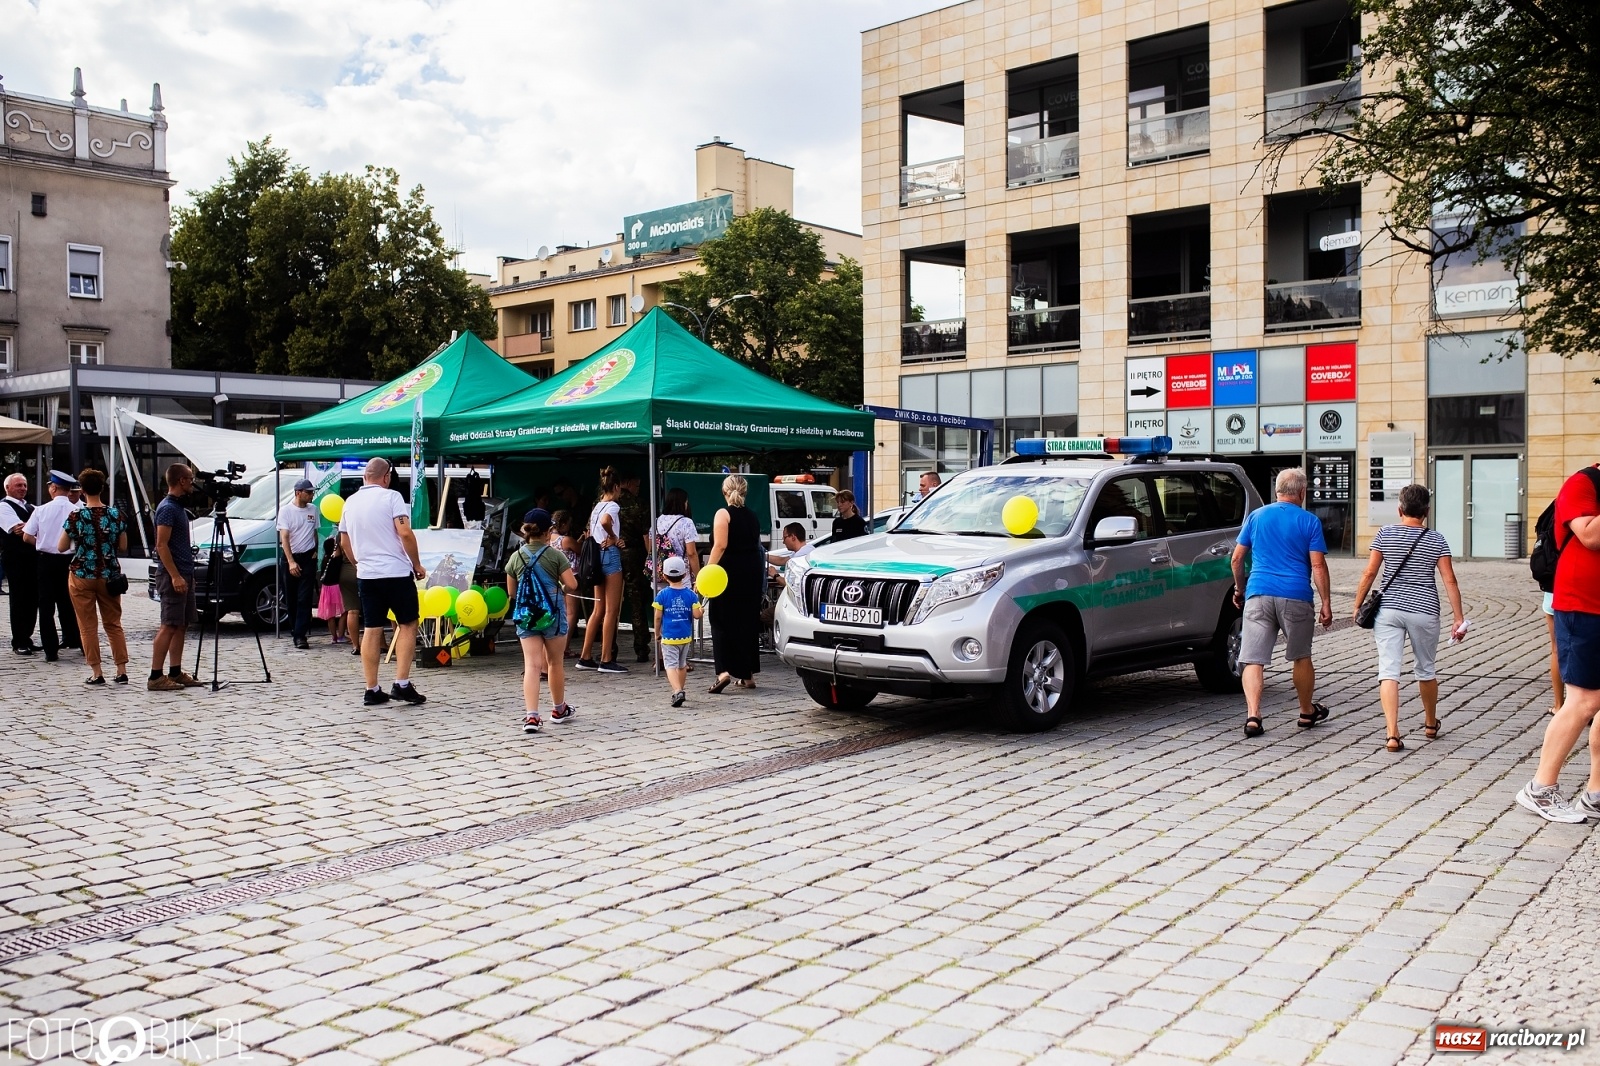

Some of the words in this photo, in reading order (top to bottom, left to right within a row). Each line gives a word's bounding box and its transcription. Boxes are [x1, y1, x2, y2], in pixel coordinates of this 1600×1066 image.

[649, 216, 705, 238] McDonald's
[627, 241, 640, 251] 300
[640, 241, 648, 249] m
[1323, 234, 1358, 249] kemøn
[1444, 284, 1513, 305] kemøn
[1136, 370, 1163, 380] PIĘTRO
[1311, 371, 1343, 380] COVEBO
[1171, 380, 1199, 389] COVEBO
[911, 411, 921, 422] Sp.
[927, 415, 939, 423] o.o.
[940, 415, 967, 426] Racibórz
[1134, 419, 1164, 430] PIĘTRO
[450, 431, 469, 442] Śląski
[470, 430, 494, 440] Oddział
[495, 428, 517, 439] Straży
[517, 425, 555, 436] Granicznej
[560, 423, 590, 433] siedzibą
[591, 423, 598, 431] w
[599, 420, 637, 430] Raciborzu
[666, 416, 692, 431] Śląski
[693, 420, 723, 431] Oddział
[724, 422, 749, 434] Straży
[750, 423, 789, 436] Granicznej
[795, 426, 824, 437] siedzibą
[832, 428, 864, 438] Raciborzu
[283, 439, 299, 450] Śląski
[298, 438, 317, 448] Oddział
[317, 437, 335, 447] Straży
[334, 436, 364, 446] Granicznej
[368, 435, 392, 445] siedzibą
[1047, 440, 1067, 452] STRAŻ
[1067, 440, 1102, 451] GRANICZNA
[1115, 568, 1150, 587] STRAŻ
[1103, 583, 1164, 609] GRANICZNA
[826, 606, 849, 620] HWA
[852, 608, 880, 624] B910
